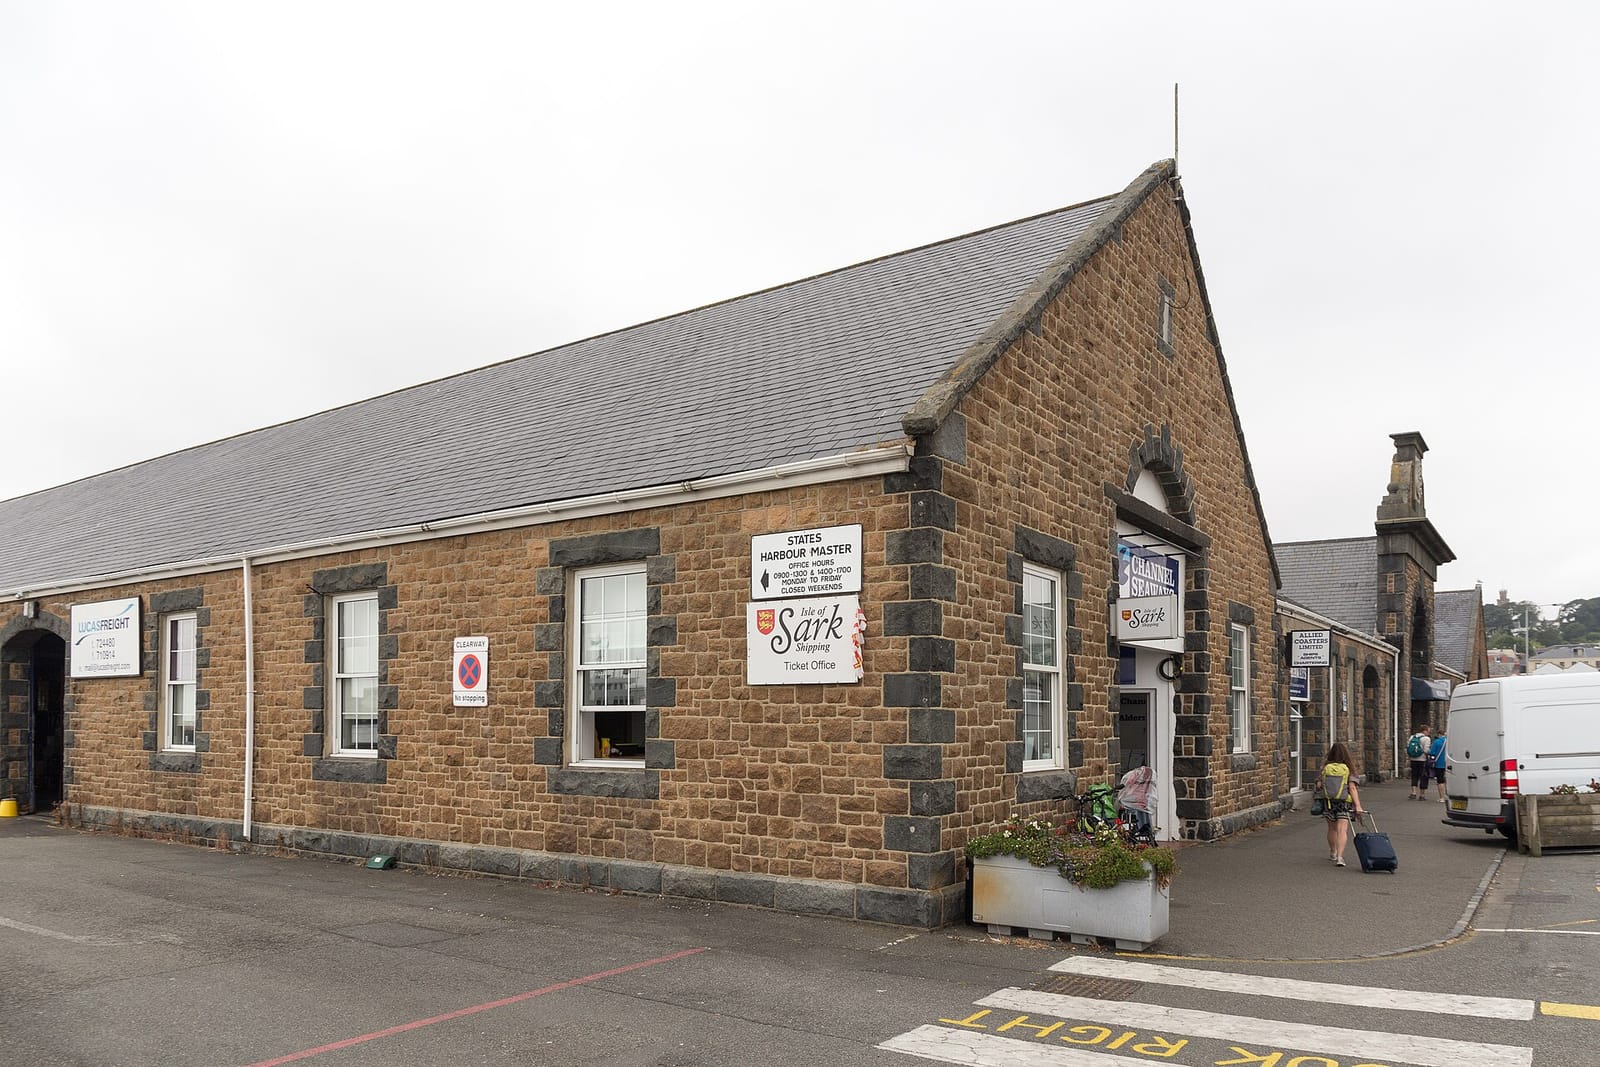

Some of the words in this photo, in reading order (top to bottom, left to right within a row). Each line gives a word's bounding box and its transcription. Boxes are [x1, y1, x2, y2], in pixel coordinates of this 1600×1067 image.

[787, 533, 822, 546] STATES
[760, 548, 806, 562] HARBOUR
[810, 544, 852, 557] MASTER
[788, 561, 809, 570] OFFICE
[811, 559, 835, 567] HOURS
[1131, 554, 1175, 587] CHANNEL
[781, 578, 807, 586] MONDAY
[820, 574, 842, 583] FRIDAY
[781, 586, 806, 594] CLOSED
[807, 583, 843, 592] WEEKENDS
[800, 607, 815, 617] Isle
[816, 605, 828, 618] of
[1128, 607, 1165, 629] Sark
[78, 617, 130, 633] LUCASFREIGHT
[770, 603, 844, 655] Sark
[455, 640, 486, 649] CLEARWAY
[795, 642, 831, 654] Shipping
[784, 661, 809, 671] Ticket
[810, 660, 836, 670] Office
[462, 694, 486, 703] stopping
[938, 1009, 1189, 1057] RIGHT
